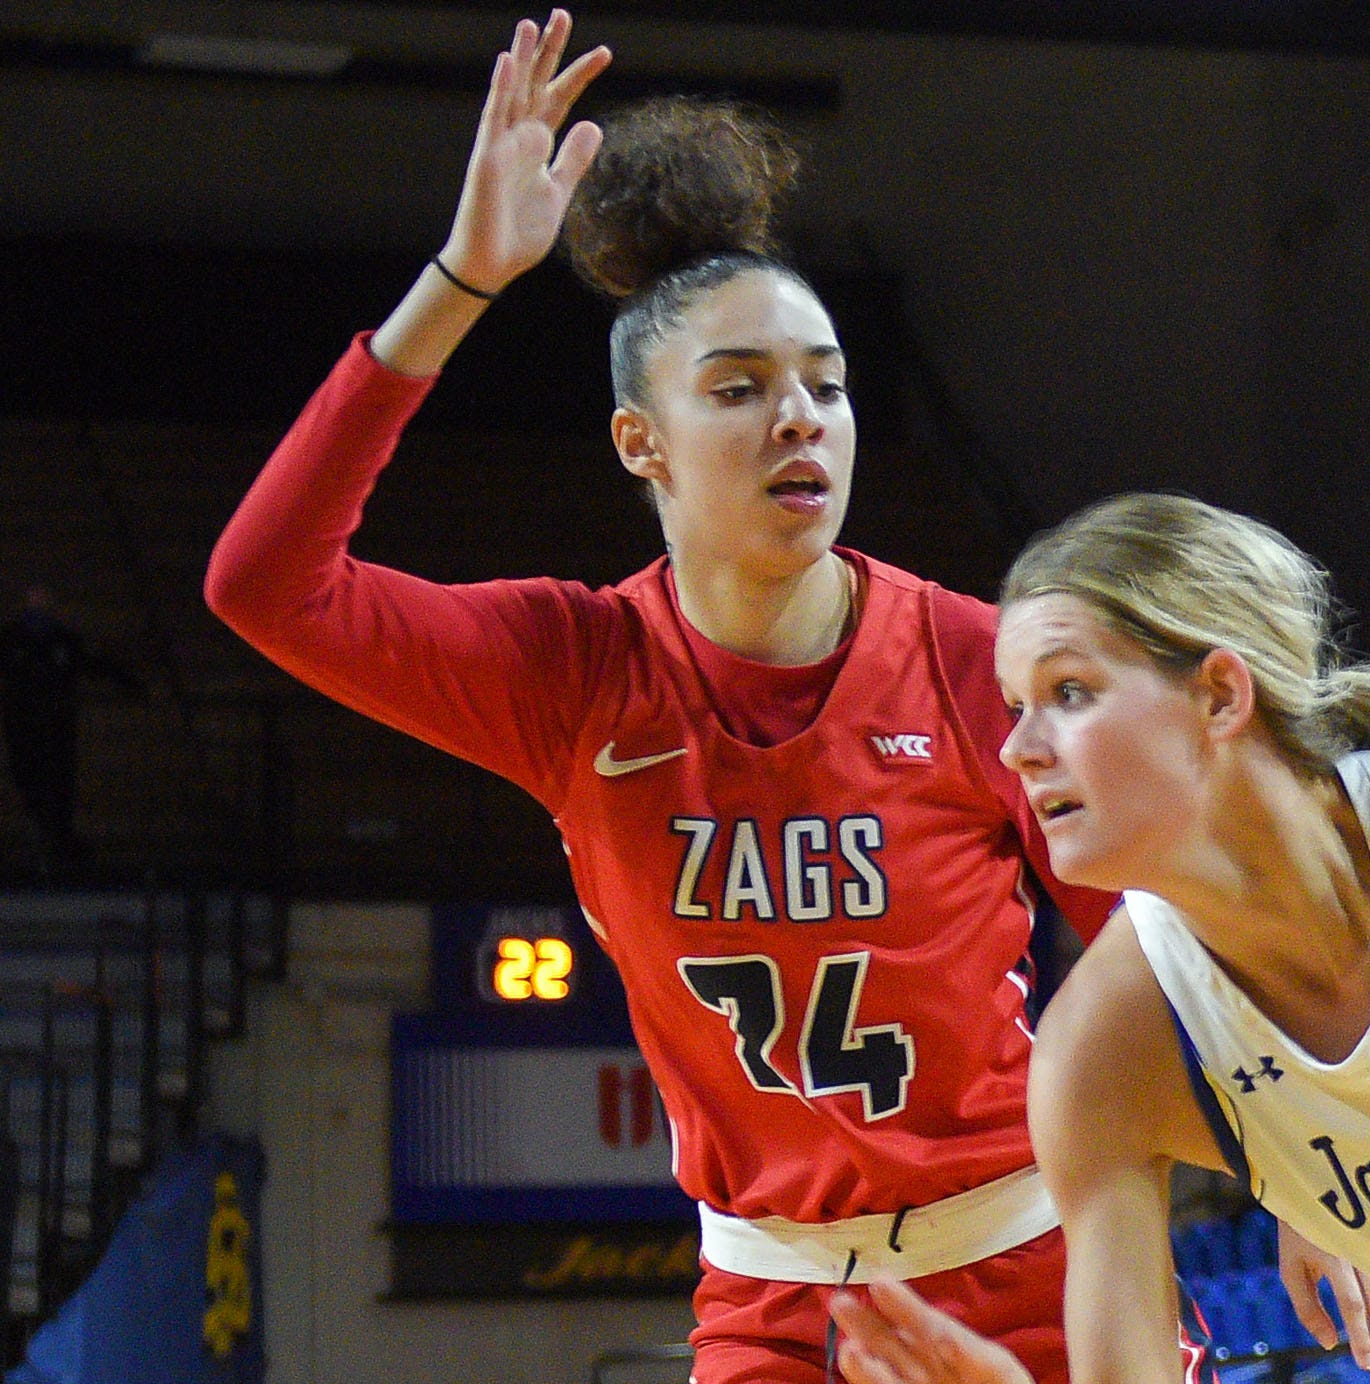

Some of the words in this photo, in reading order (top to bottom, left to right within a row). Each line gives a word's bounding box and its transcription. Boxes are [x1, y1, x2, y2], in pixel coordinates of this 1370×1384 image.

[870, 734, 932, 758] WCC
[669, 815, 889, 922] ZAGS
[494, 937, 573, 1000] 22
